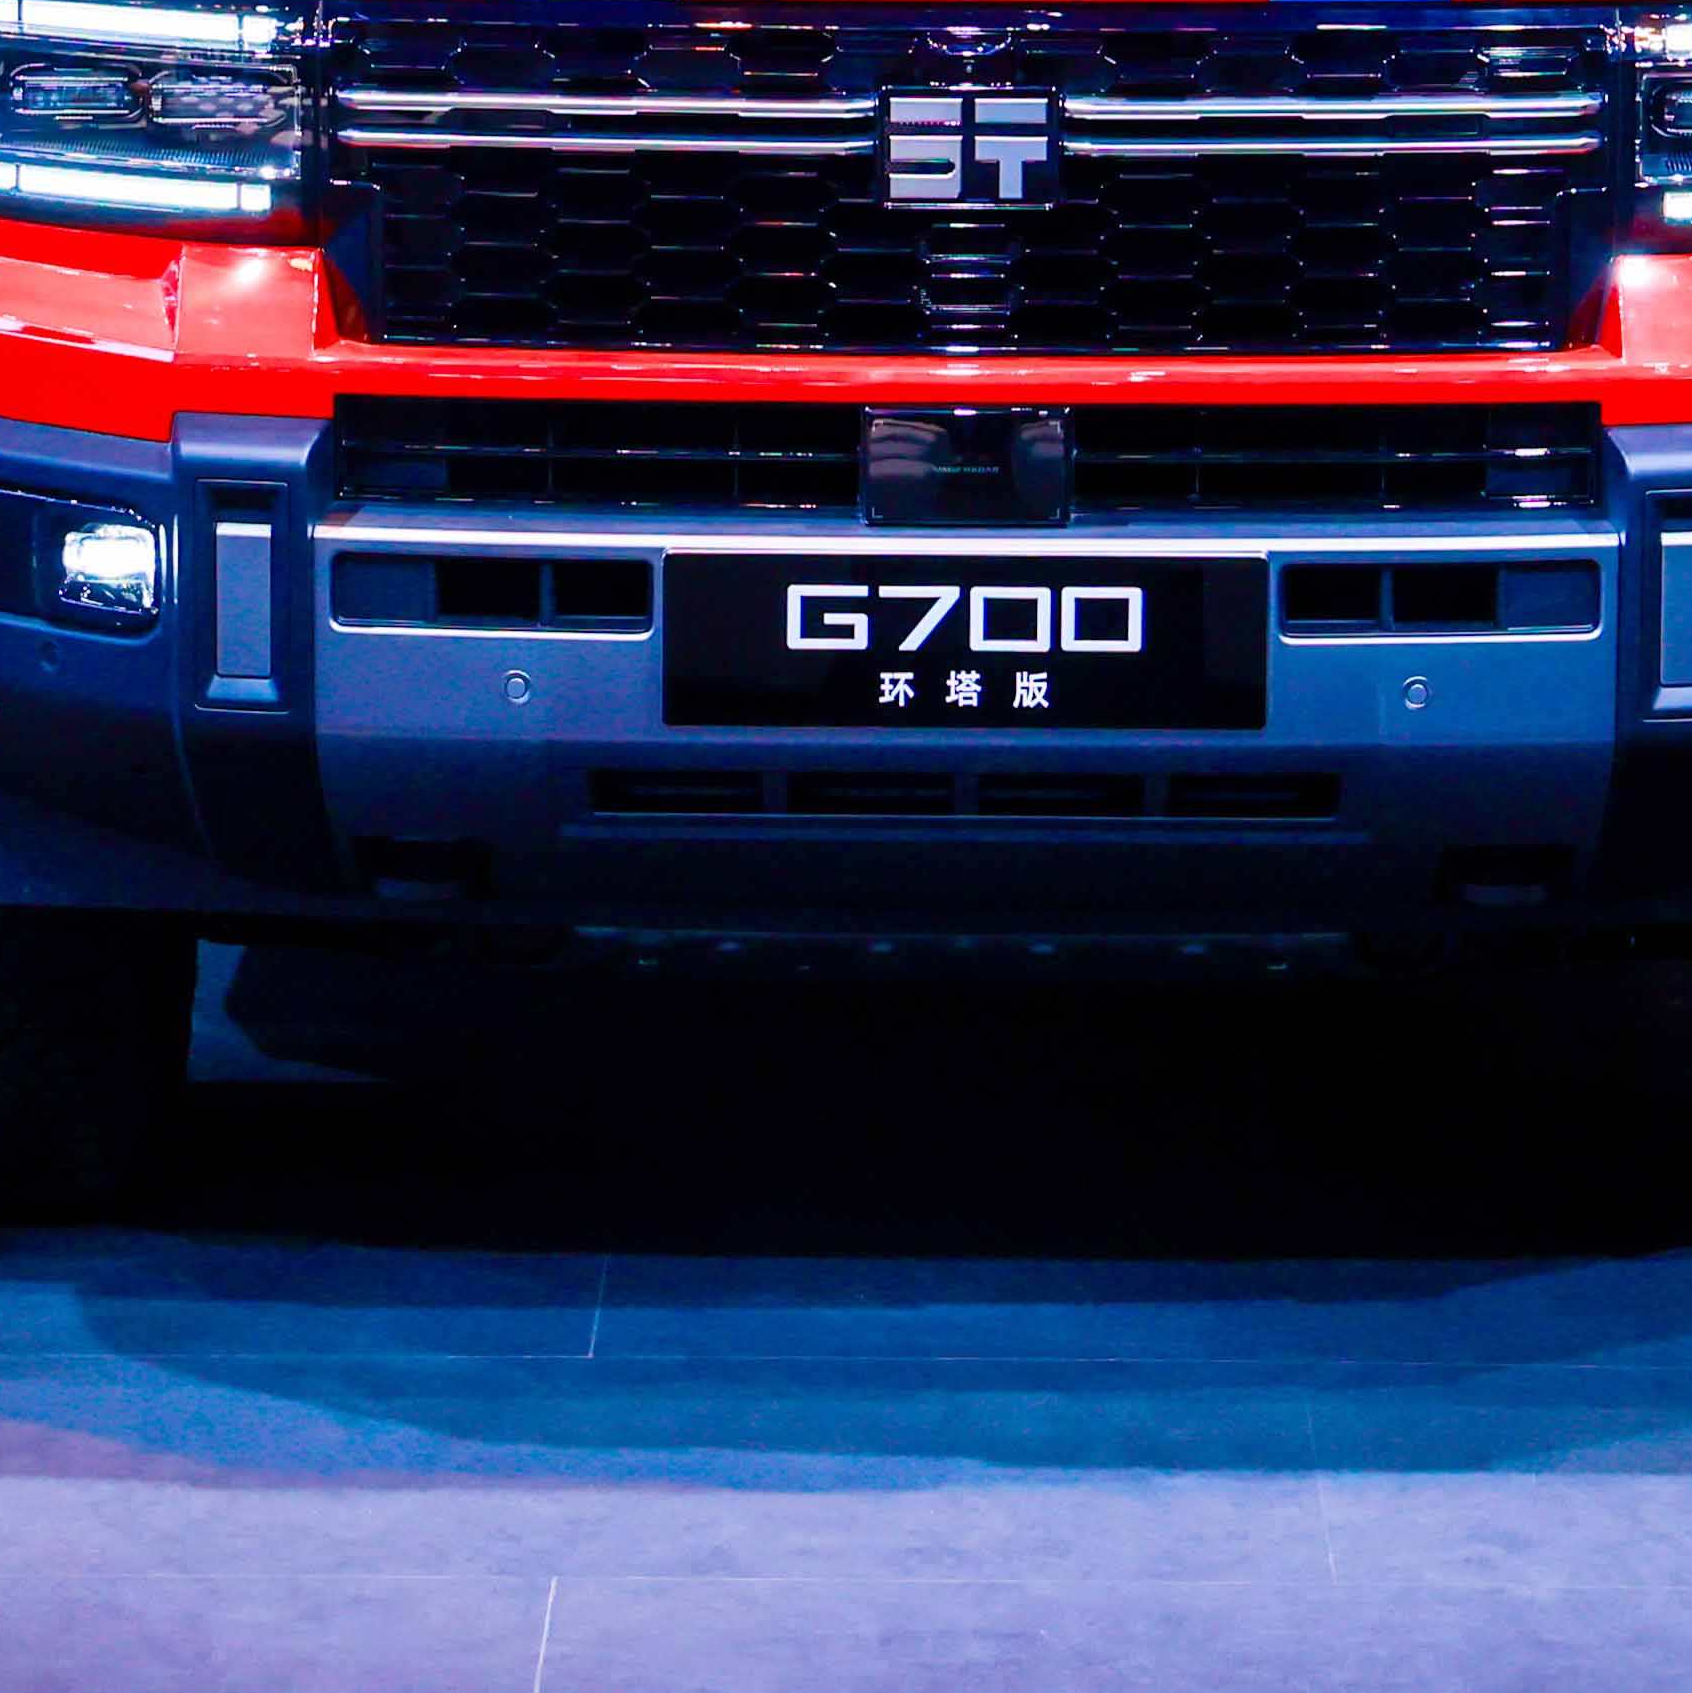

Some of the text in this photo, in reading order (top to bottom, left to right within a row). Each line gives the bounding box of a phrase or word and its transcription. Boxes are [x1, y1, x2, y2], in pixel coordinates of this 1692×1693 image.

[786, 584, 1143, 653] G700
[878, 670, 1050, 709] 环塔版
